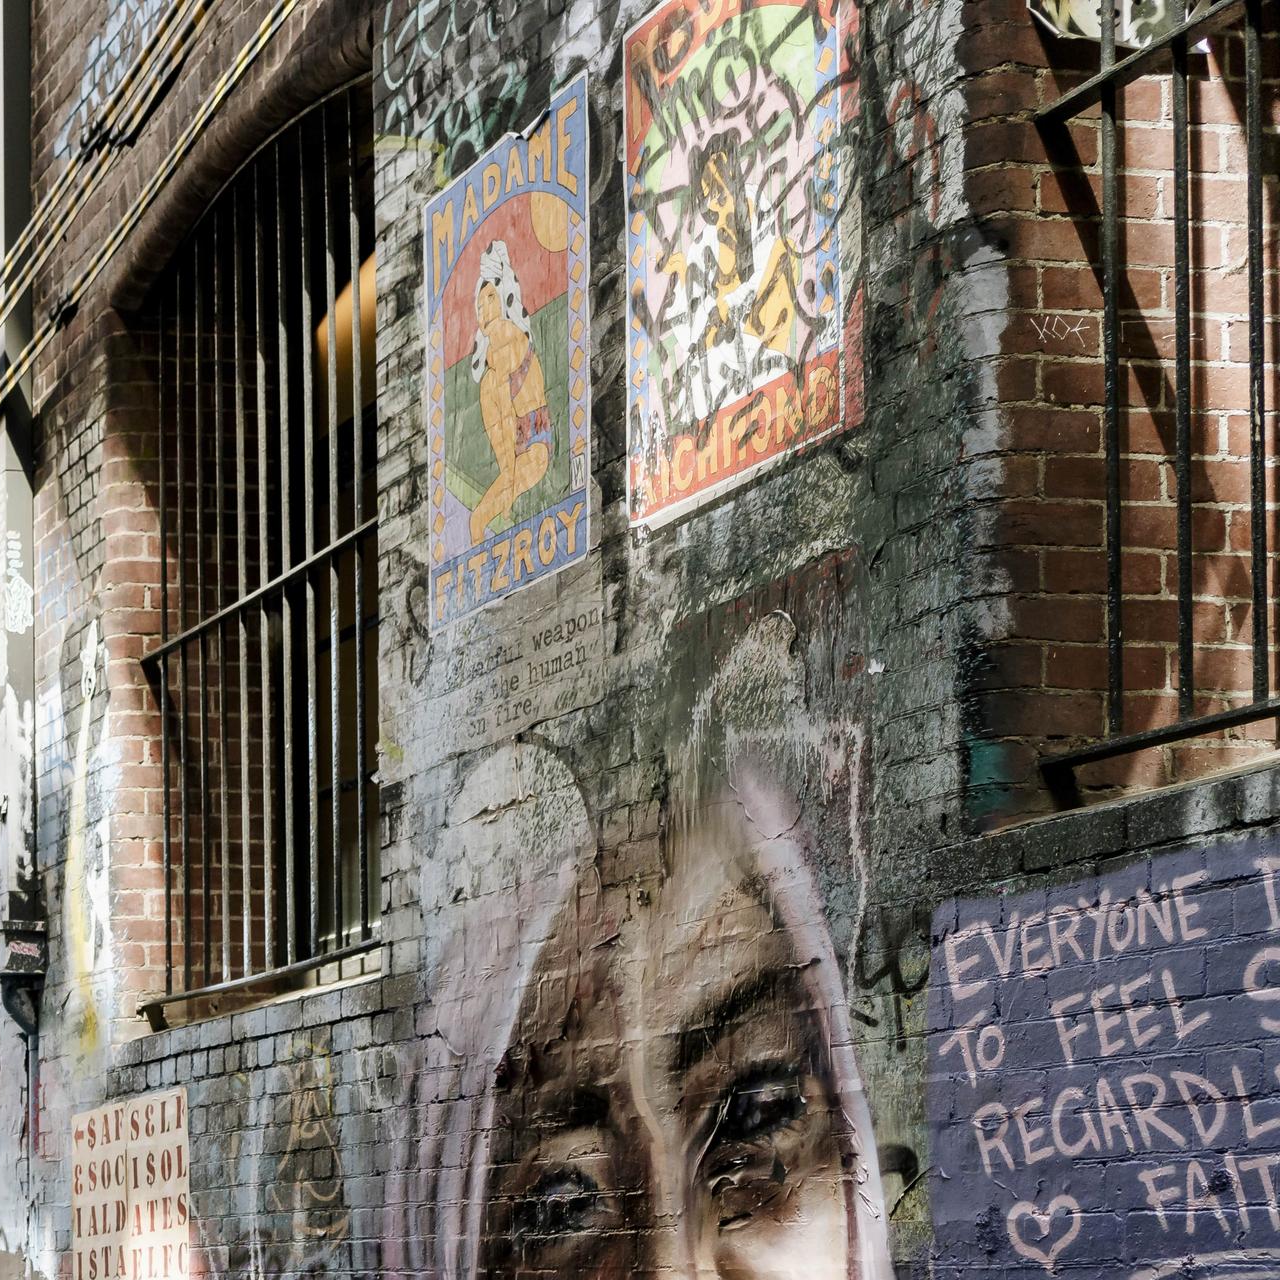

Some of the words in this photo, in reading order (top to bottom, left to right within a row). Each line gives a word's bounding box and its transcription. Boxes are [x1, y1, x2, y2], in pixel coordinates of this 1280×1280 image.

[432, 96, 579, 297] MADAME
[433, 503, 585, 622] FITZROY
[490, 674, 520, 700] the
[528, 647, 589, 686] human
[532, 607, 601, 653] weapon
[942, 868, 1210, 1004] EVERYONE
[938, 1009, 1007, 1089] TO
[1053, 968, 1211, 1067] FEEL
